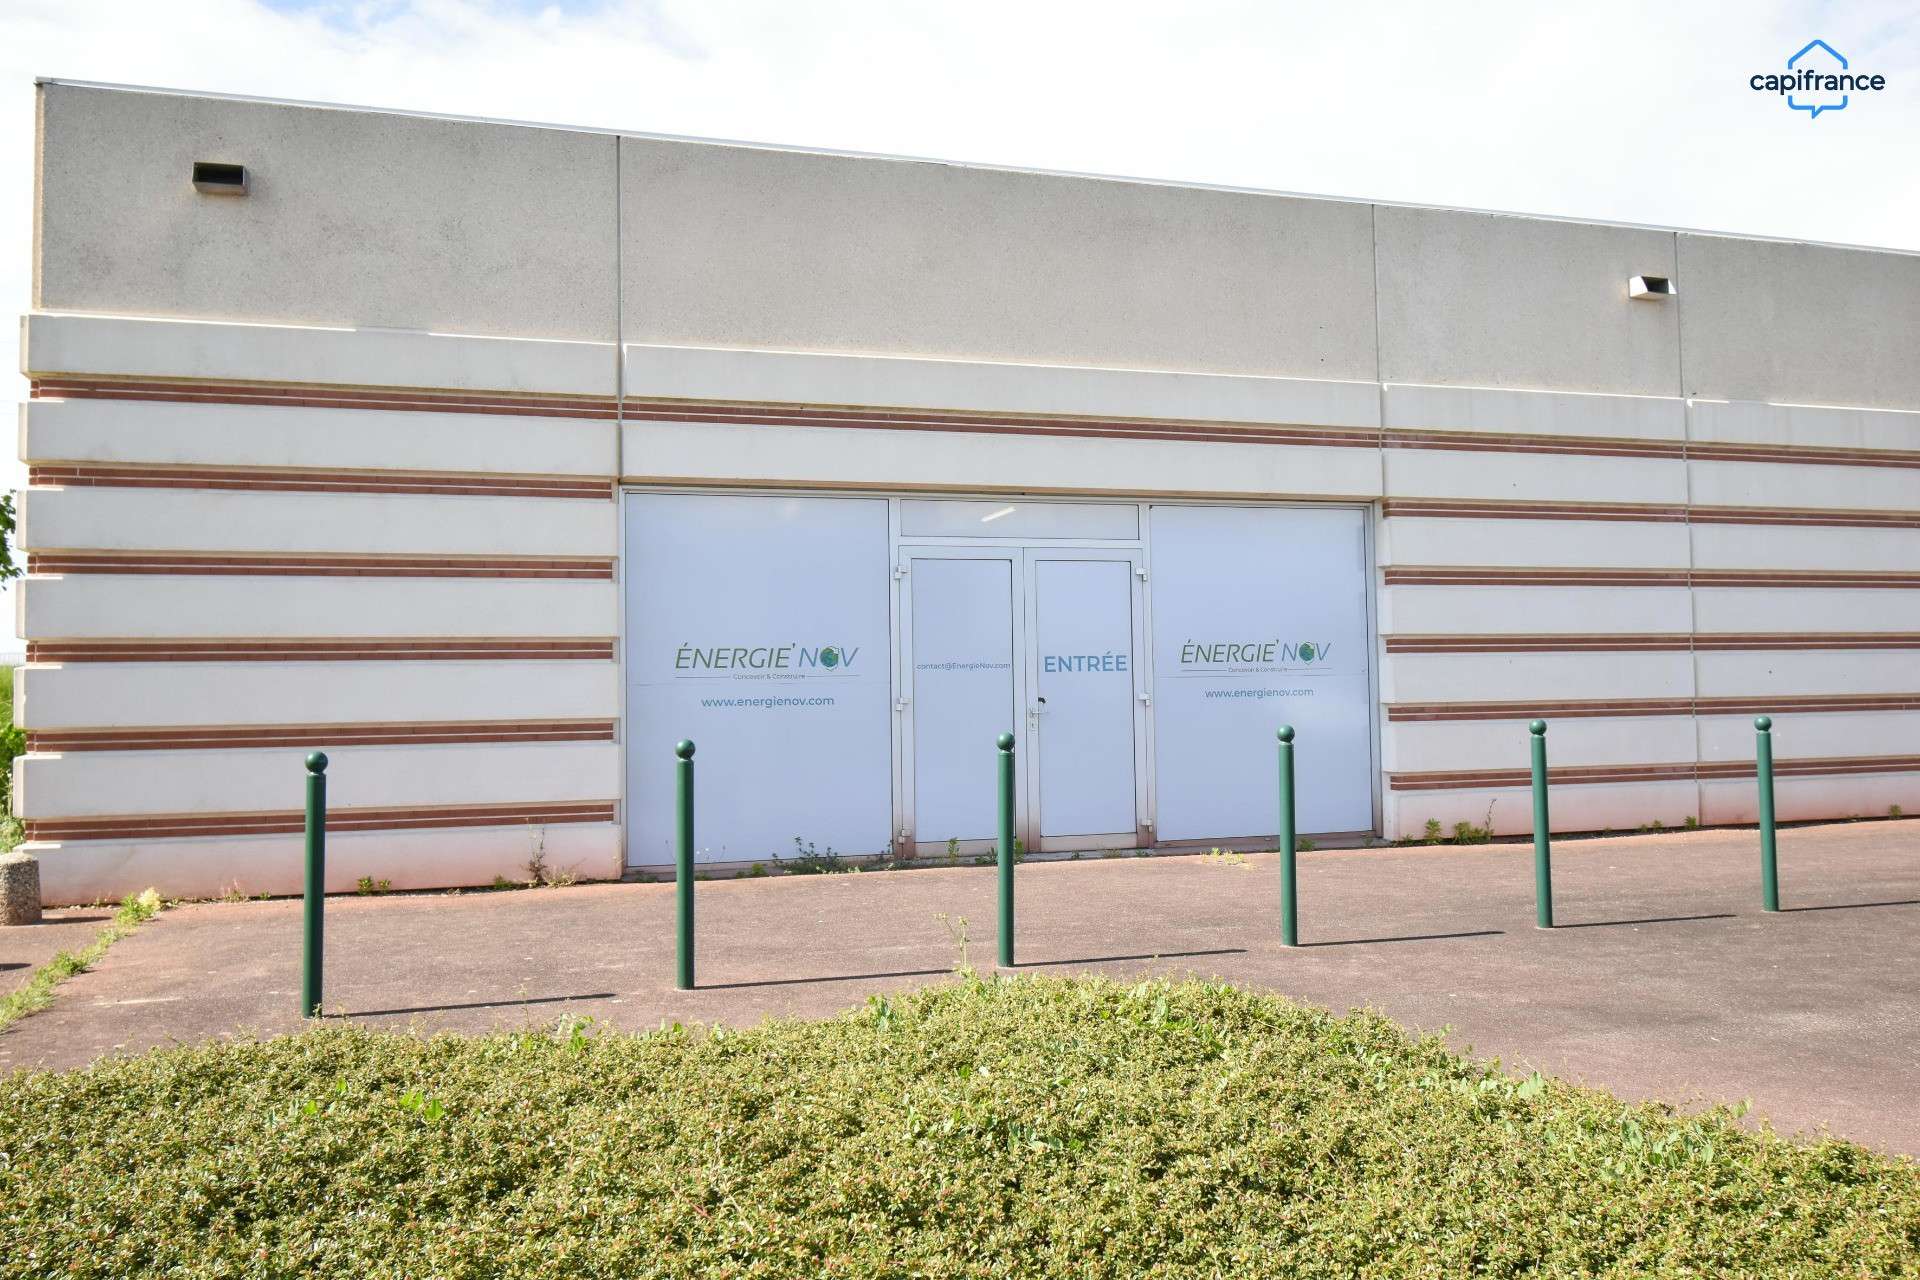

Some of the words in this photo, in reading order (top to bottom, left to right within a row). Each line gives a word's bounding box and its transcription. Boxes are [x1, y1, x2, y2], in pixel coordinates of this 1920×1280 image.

[1044, 651, 1127, 672] ENTRÉE
[1205, 688, 1314, 699] www.energienov.com
[701, 697, 834, 708] www.energienov.com
